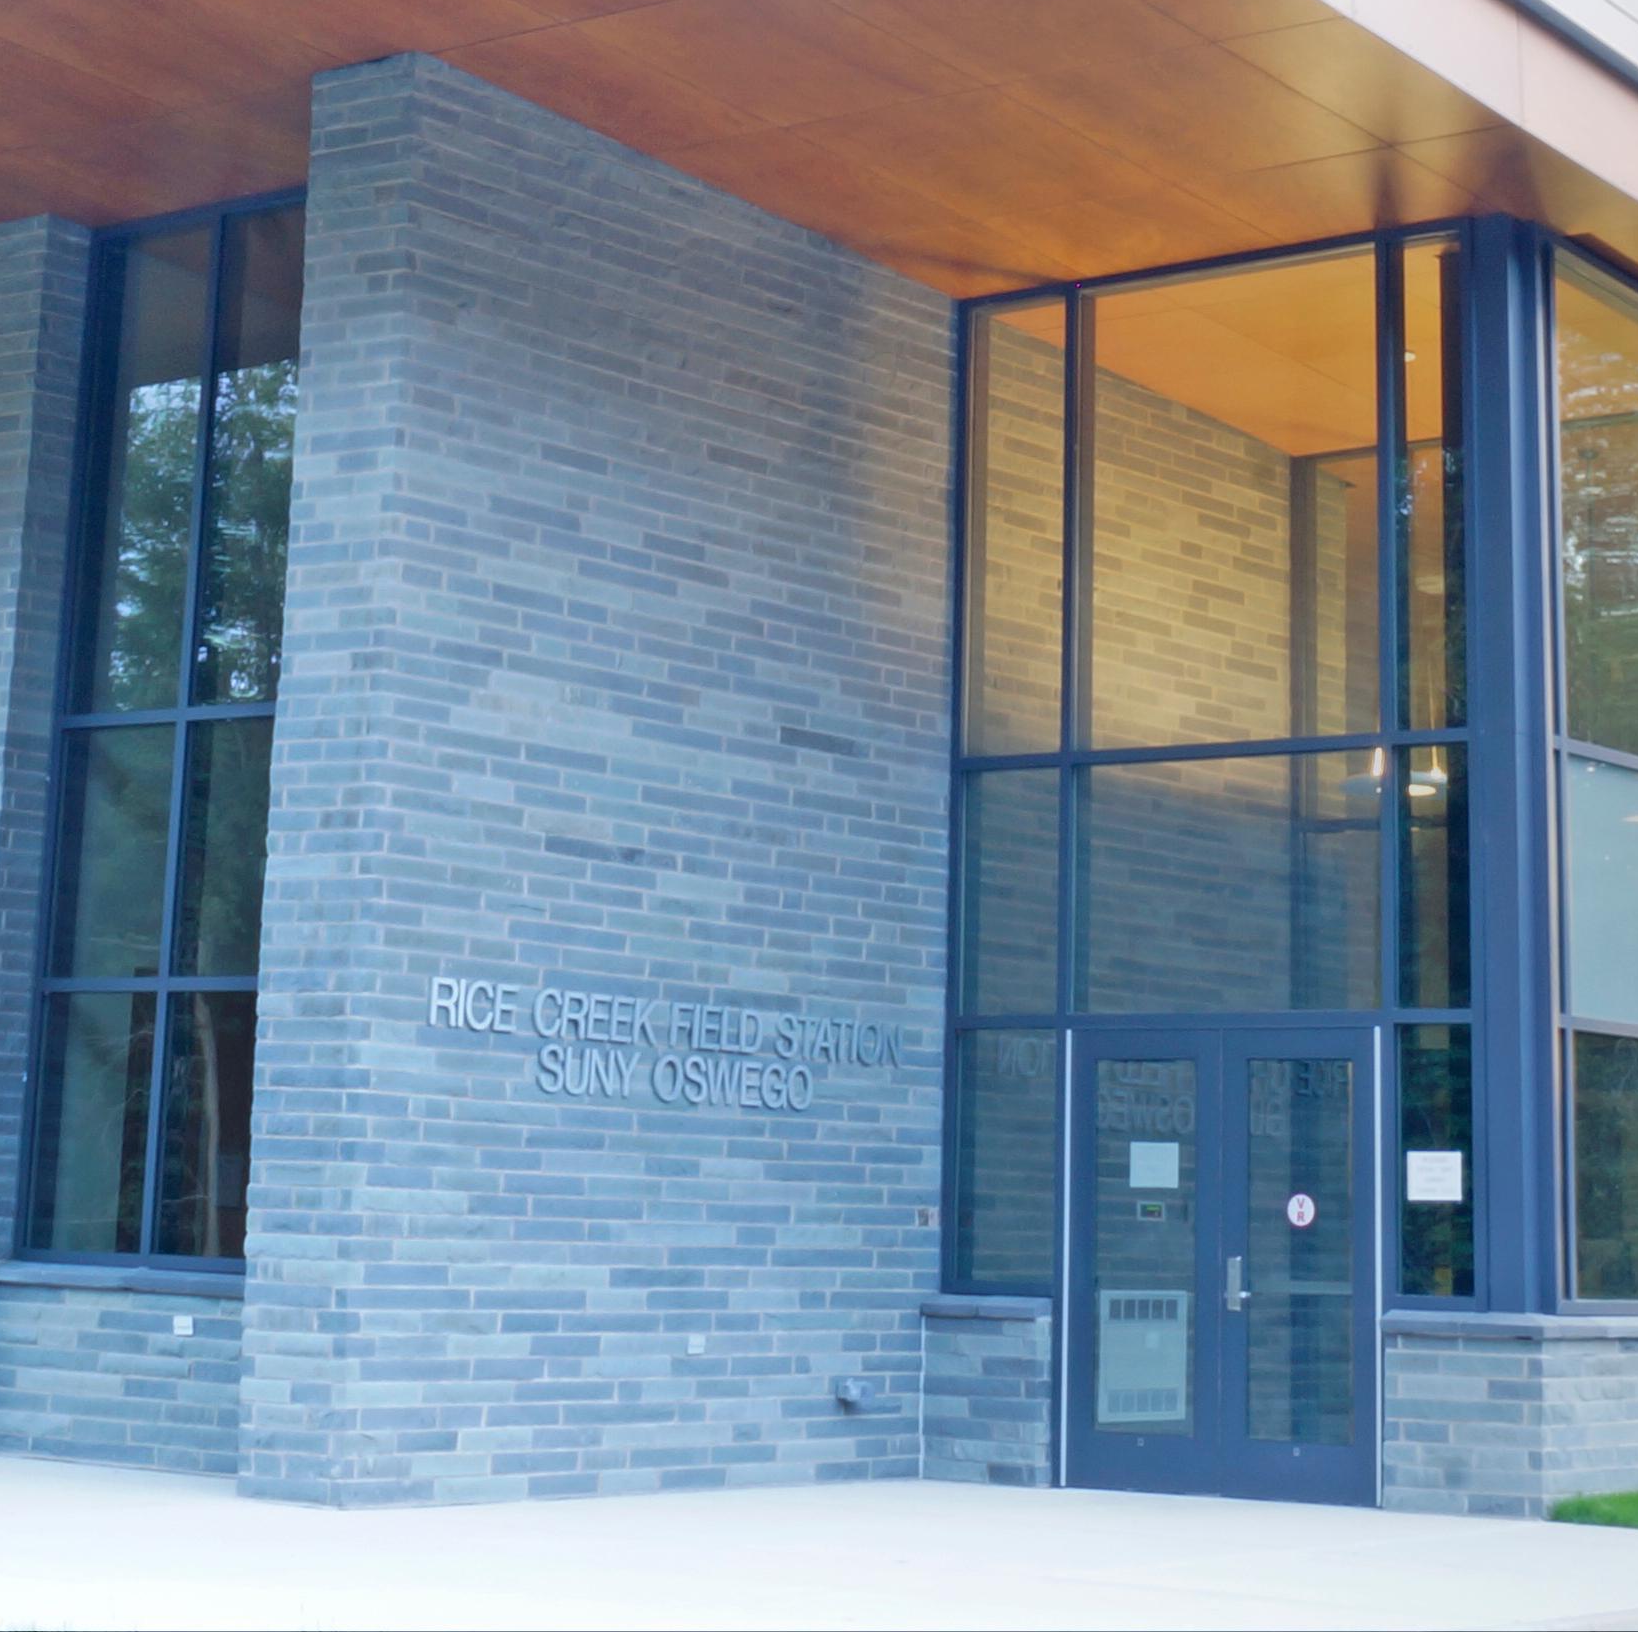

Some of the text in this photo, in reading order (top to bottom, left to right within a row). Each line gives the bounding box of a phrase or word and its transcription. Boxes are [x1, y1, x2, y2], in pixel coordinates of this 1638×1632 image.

[429, 977, 902, 1067] RICE CREEK FIELD STATION
[536, 1043, 812, 1112] SUNY OSWEGO
